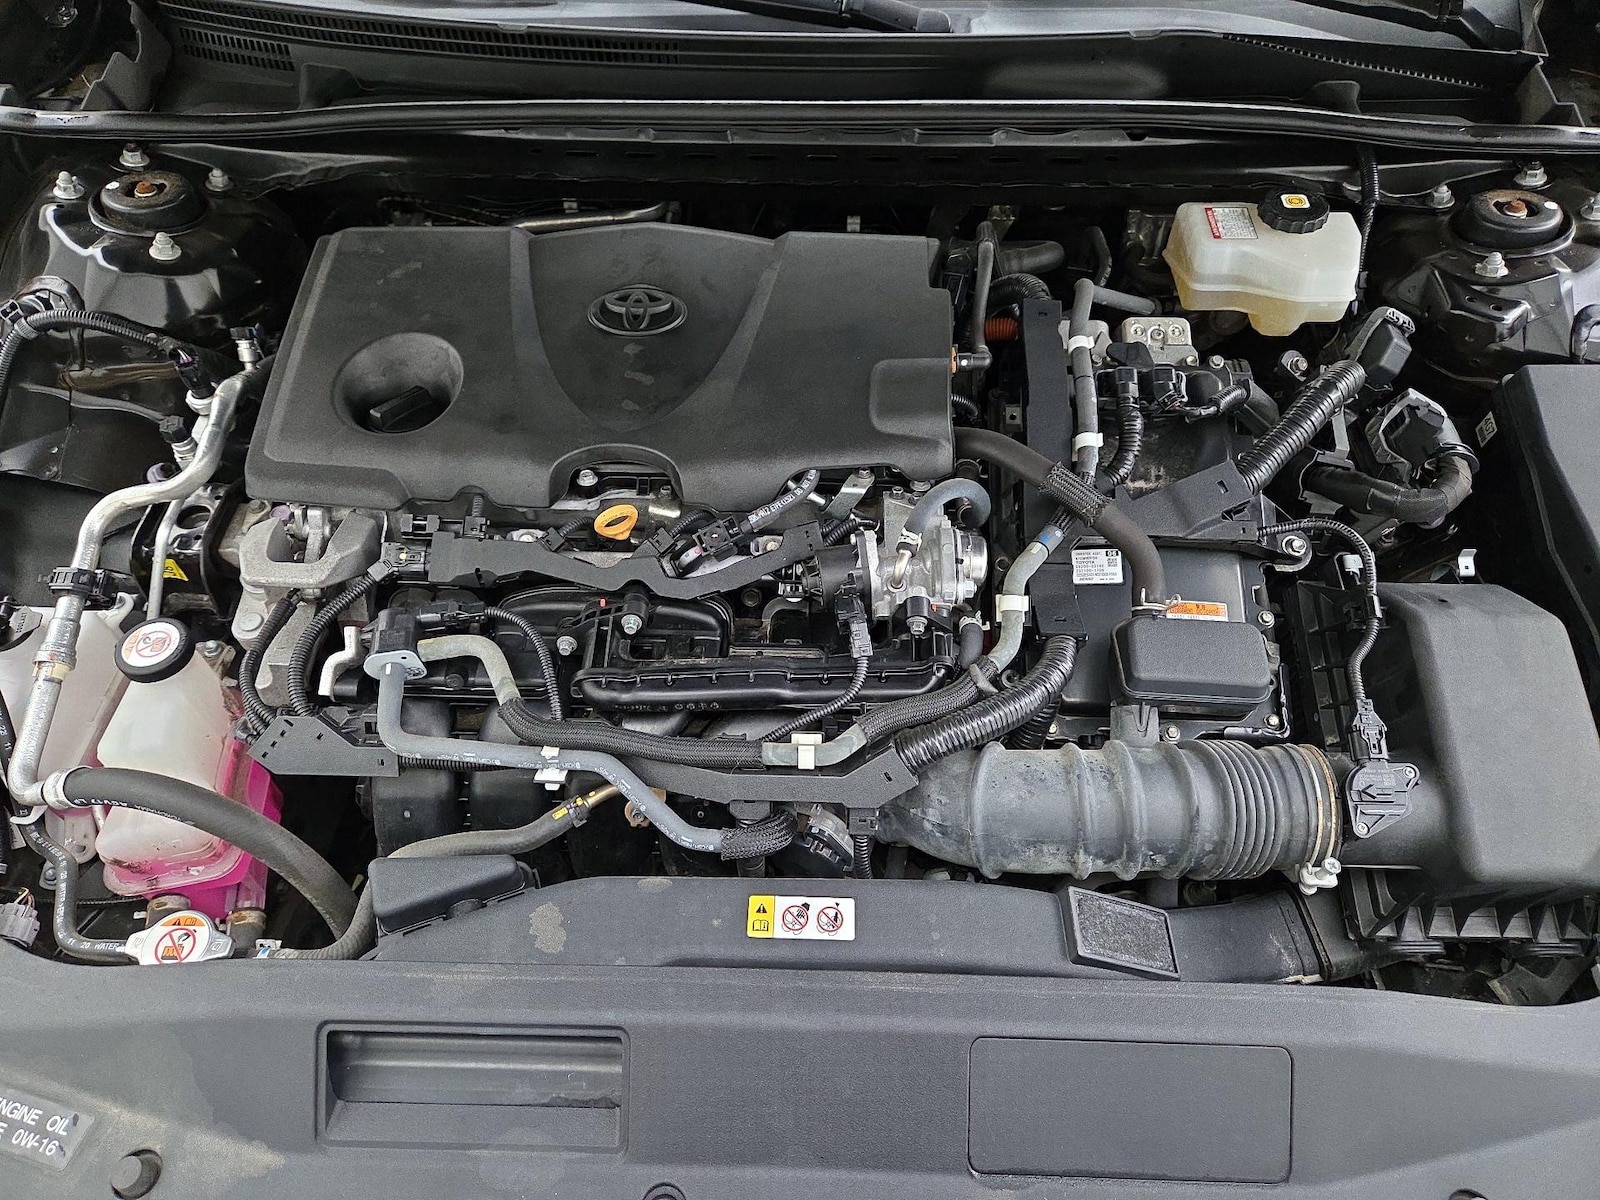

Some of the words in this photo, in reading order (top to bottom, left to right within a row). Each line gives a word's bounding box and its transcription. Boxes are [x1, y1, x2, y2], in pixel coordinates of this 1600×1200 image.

[0, 1097, 43, 1126] NGINE
[46, 1115, 70, 1136] OIL
[11, 1128, 60, 1157] 0W-16
